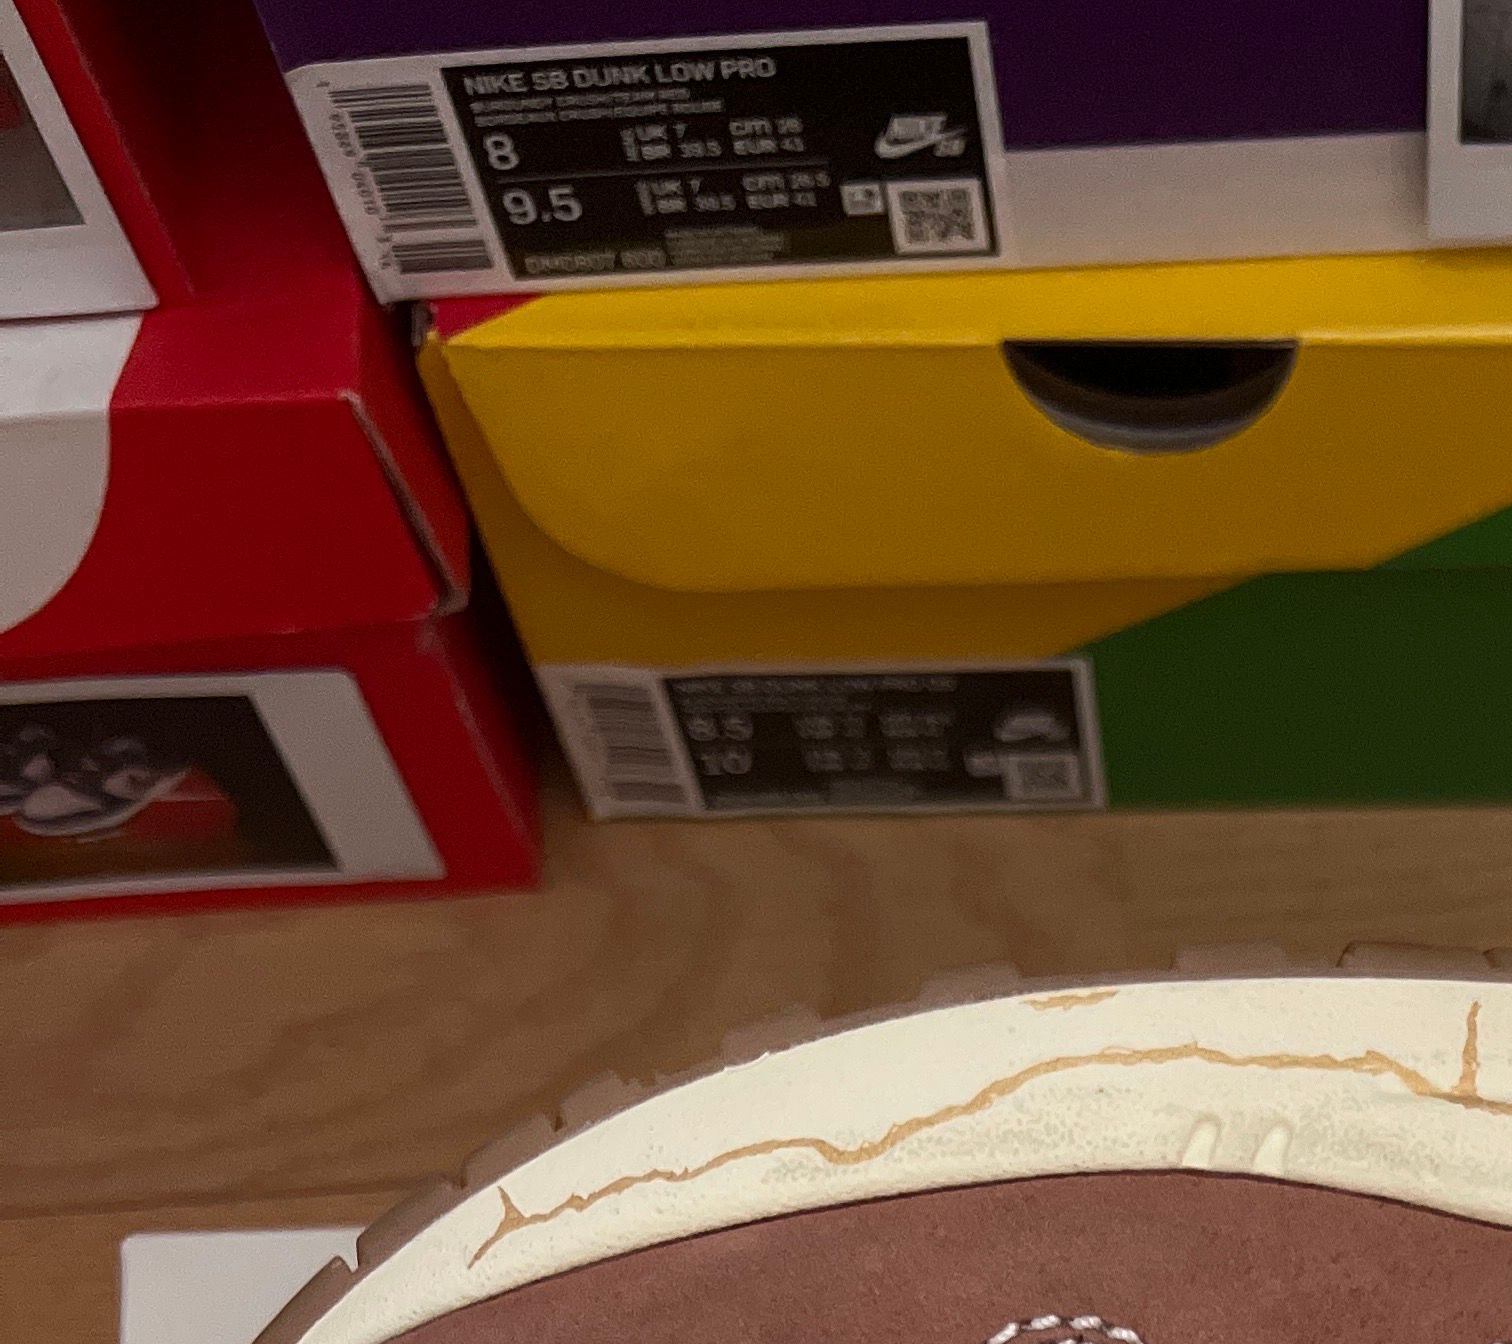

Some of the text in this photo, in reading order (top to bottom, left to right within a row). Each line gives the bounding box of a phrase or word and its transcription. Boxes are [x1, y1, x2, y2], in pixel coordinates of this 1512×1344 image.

[463, 56, 777, 96] NIKE SB DUNK LOW PRO
[483, 131, 520, 171] 8
[502, 184, 583, 225] 9.5
